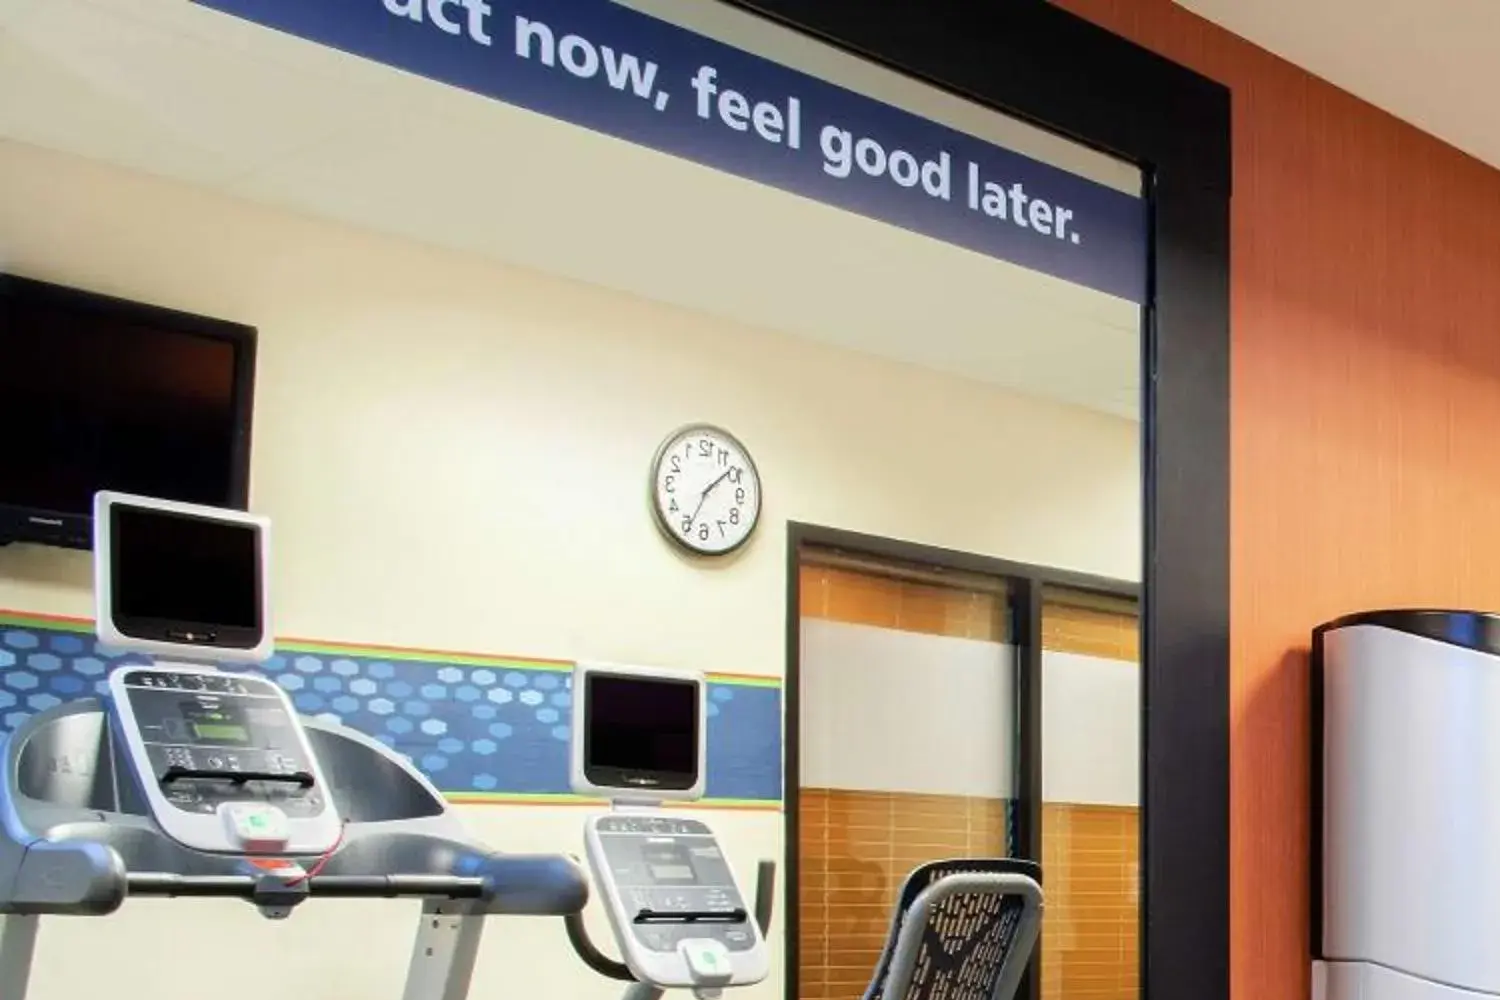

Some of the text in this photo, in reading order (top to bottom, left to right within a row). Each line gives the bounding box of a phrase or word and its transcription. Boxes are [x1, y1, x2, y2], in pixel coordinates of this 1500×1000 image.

[515, 15, 669, 111] now,
[692, 65, 800, 149] feel
[820, 123, 950, 200] good
[968, 162, 1080, 244] later.
